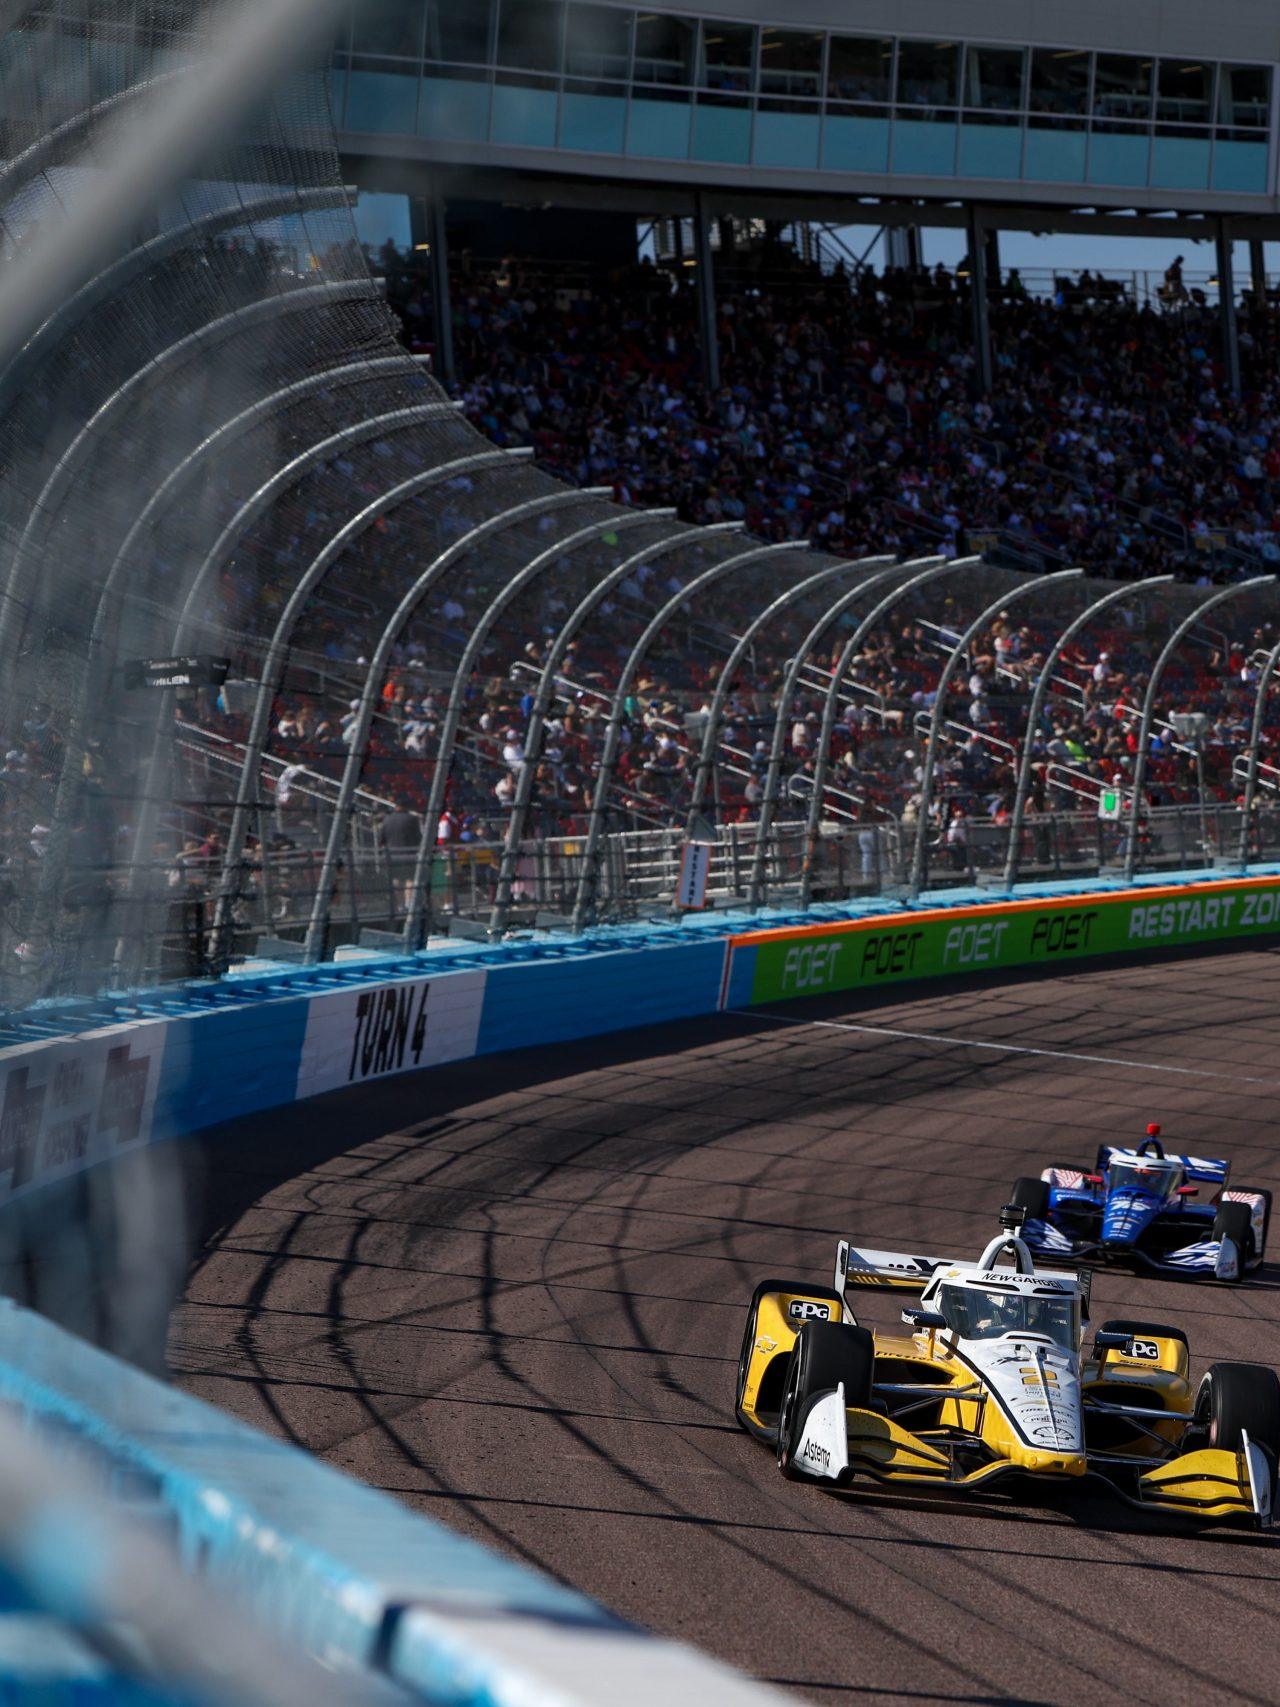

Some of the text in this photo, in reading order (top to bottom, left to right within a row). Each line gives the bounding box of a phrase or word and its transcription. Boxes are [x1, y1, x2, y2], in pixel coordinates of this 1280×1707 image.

[782, 943, 842, 989] POET
[860, 932, 923, 977] POET
[943, 921, 1008, 966] POET
[1030, 912, 1098, 955] POET
[1128, 896, 1236, 939] RESTART
[348, 983, 430, 1081] TURN 4
[982, 1273, 1064, 1290] NEWGARDEN
[790, 1302, 829, 1319] PPG
